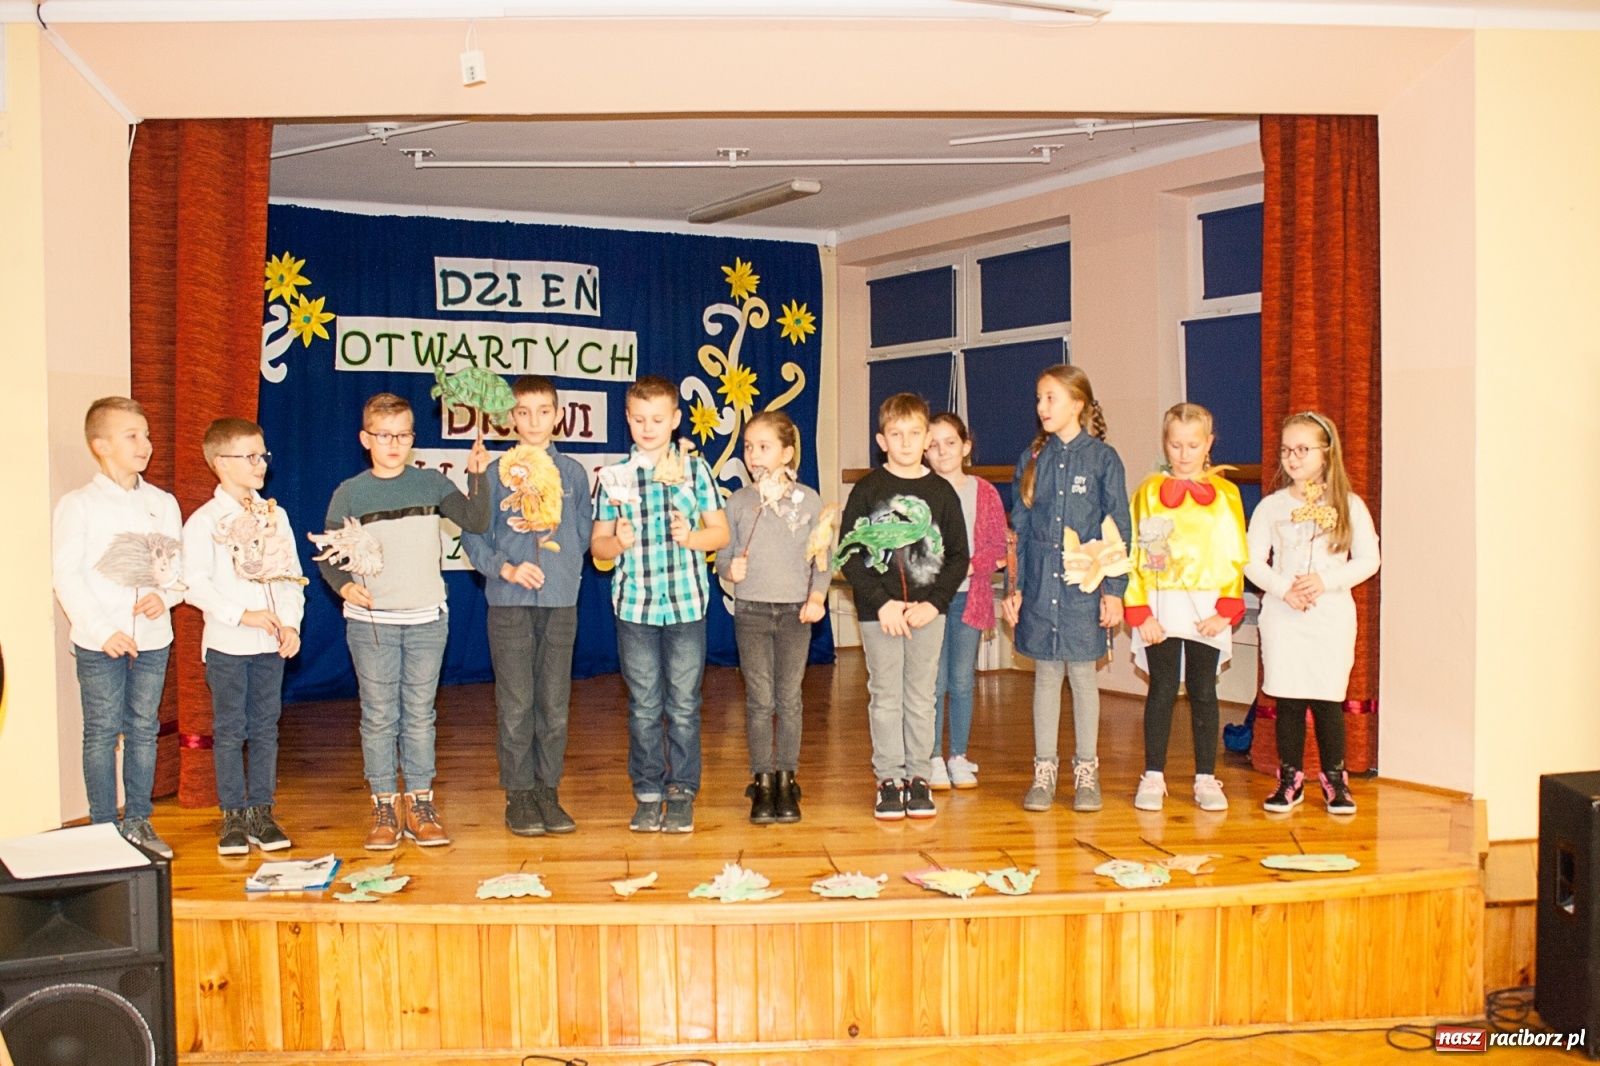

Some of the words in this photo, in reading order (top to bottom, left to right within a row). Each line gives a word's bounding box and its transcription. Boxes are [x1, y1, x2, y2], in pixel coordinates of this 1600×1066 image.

[439, 268, 598, 311] DZIEŃ
[341, 330, 634, 375] OTWARTYCH
[447, 402, 593, 438] DRWI
